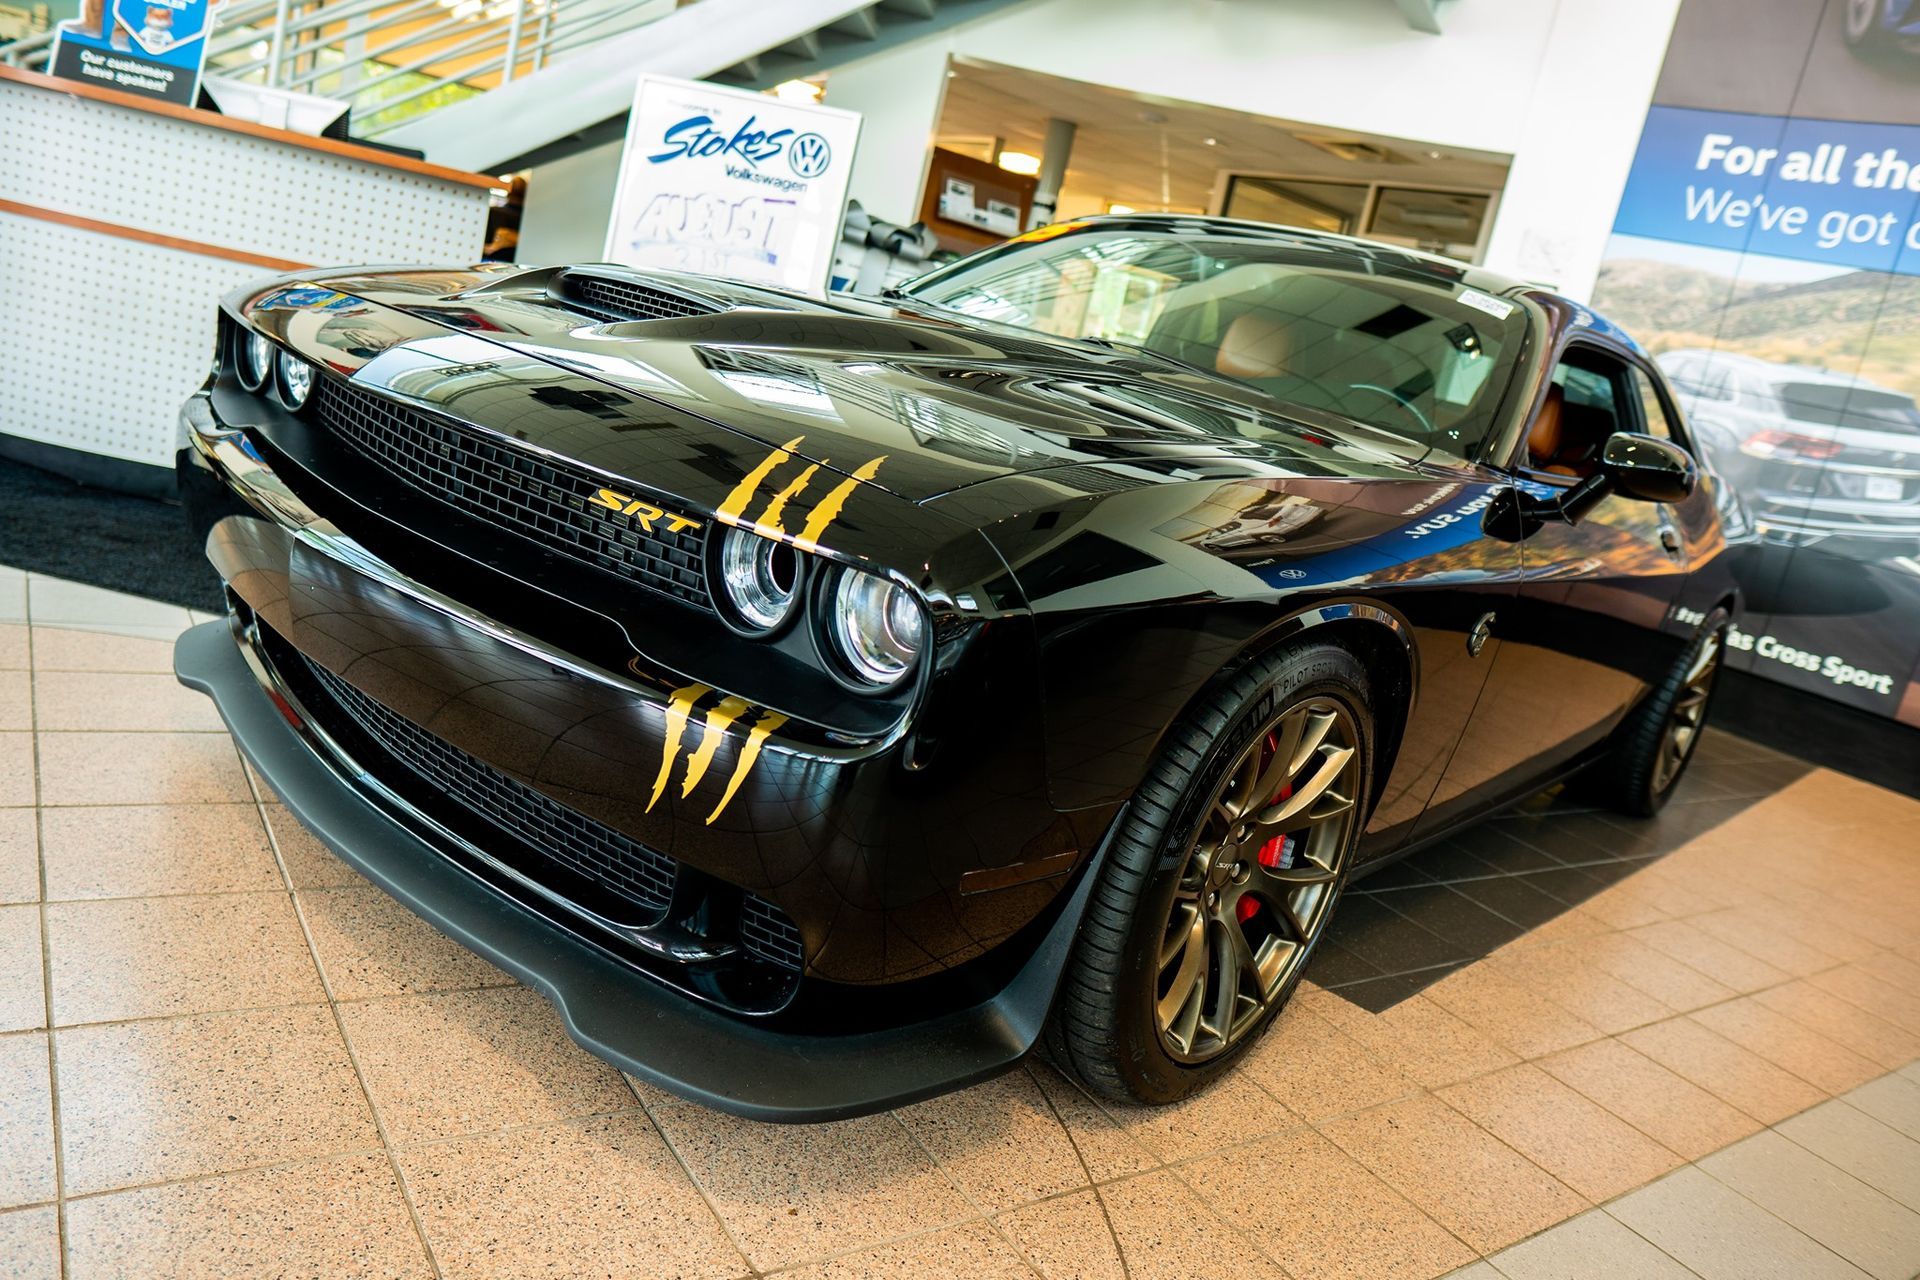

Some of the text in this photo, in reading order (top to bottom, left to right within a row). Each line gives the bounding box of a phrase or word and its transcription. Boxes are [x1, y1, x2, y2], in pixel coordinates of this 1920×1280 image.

[80, 49, 174, 81] Our customers
[82, 62, 115, 80] have
[648, 115, 795, 168] Stokes
[1696, 133, 1778, 176] For
[1779, 144, 1847, 185] all
[725, 164, 808, 192] Volkswagen
[1686, 185, 1808, 235] We've
[1816, 210, 1898, 248] got
[588, 489, 701, 533] SRT
[1282, 667, 1309, 694] PILOT
[1756, 635, 1821, 672] Cross
[1821, 656, 1894, 694] Sport
